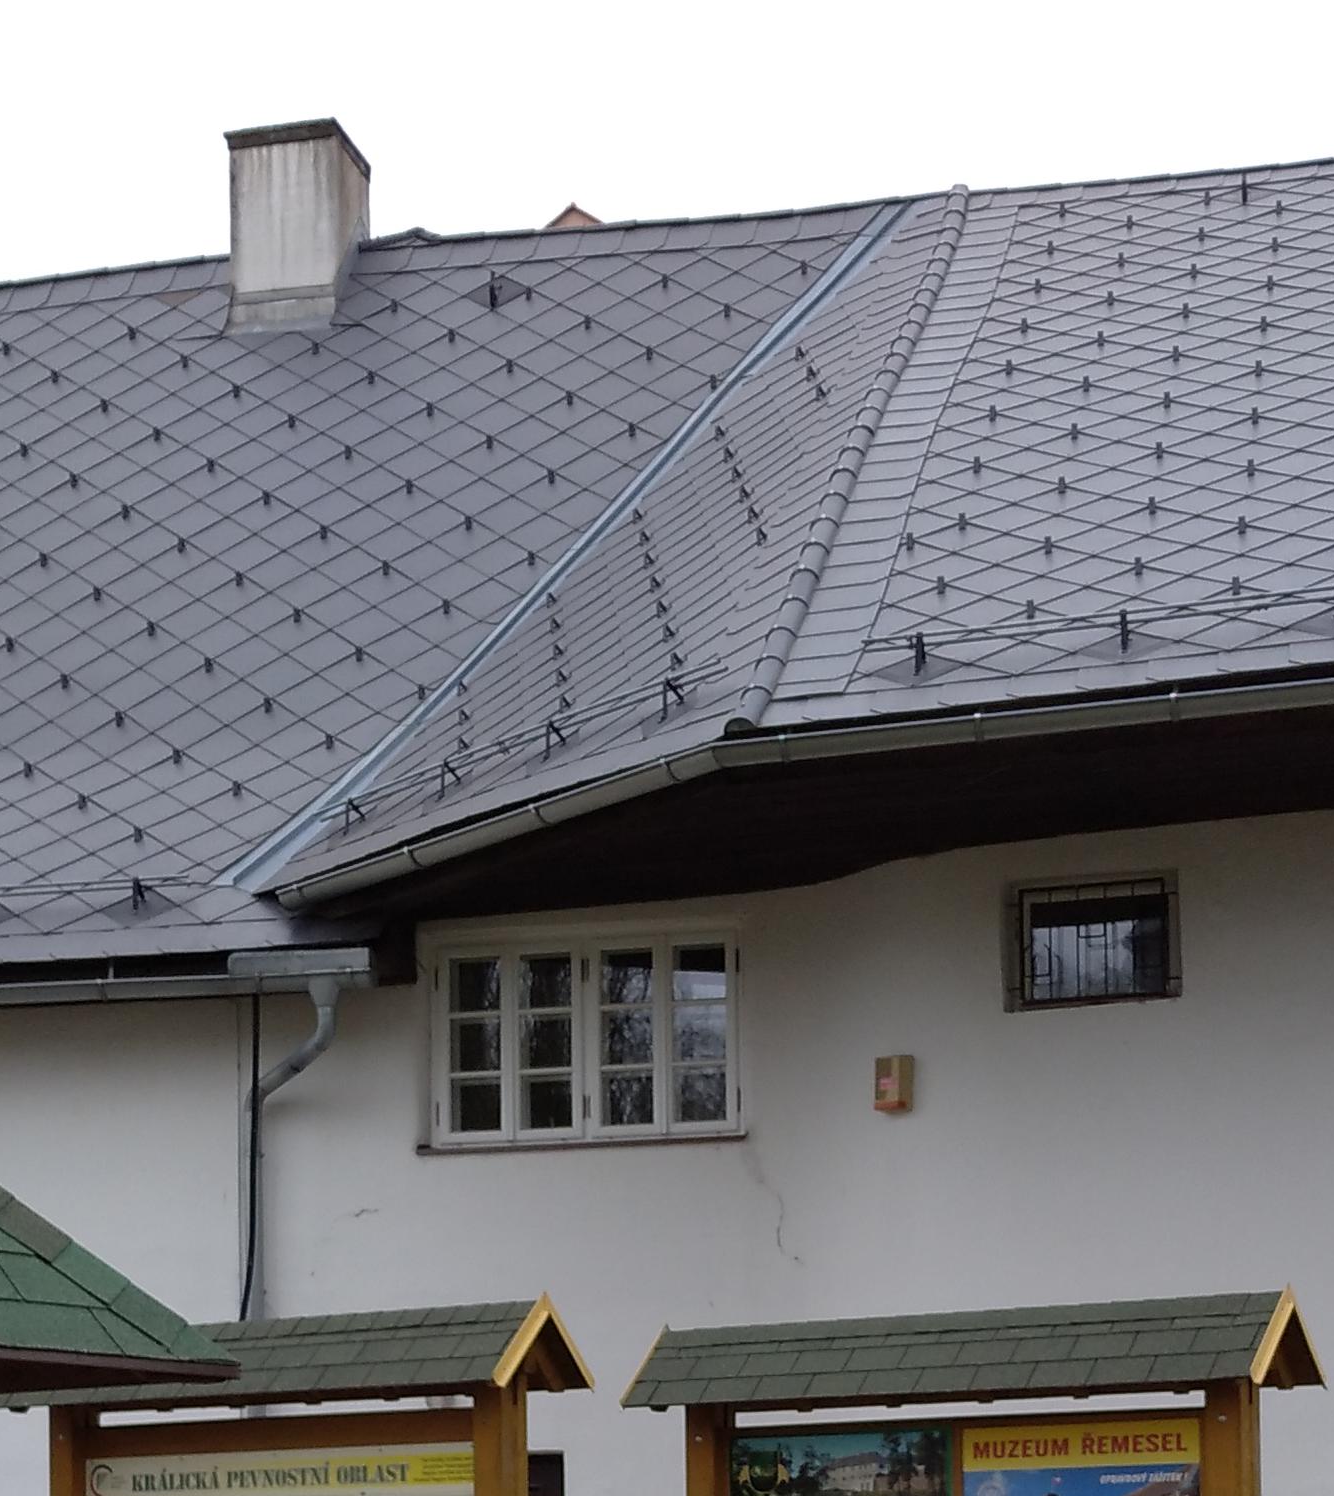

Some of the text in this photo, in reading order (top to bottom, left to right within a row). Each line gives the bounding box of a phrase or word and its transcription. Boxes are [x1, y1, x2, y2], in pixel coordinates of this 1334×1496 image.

[972, 1432, 1188, 1459] MUZEUM ŘEMESEL
[131, 1465, 219, 1492] KRÁLICKÁ
[226, 1461, 330, 1489] PEVNOSTNÍ
[336, 1463, 410, 1484] OBLAST
